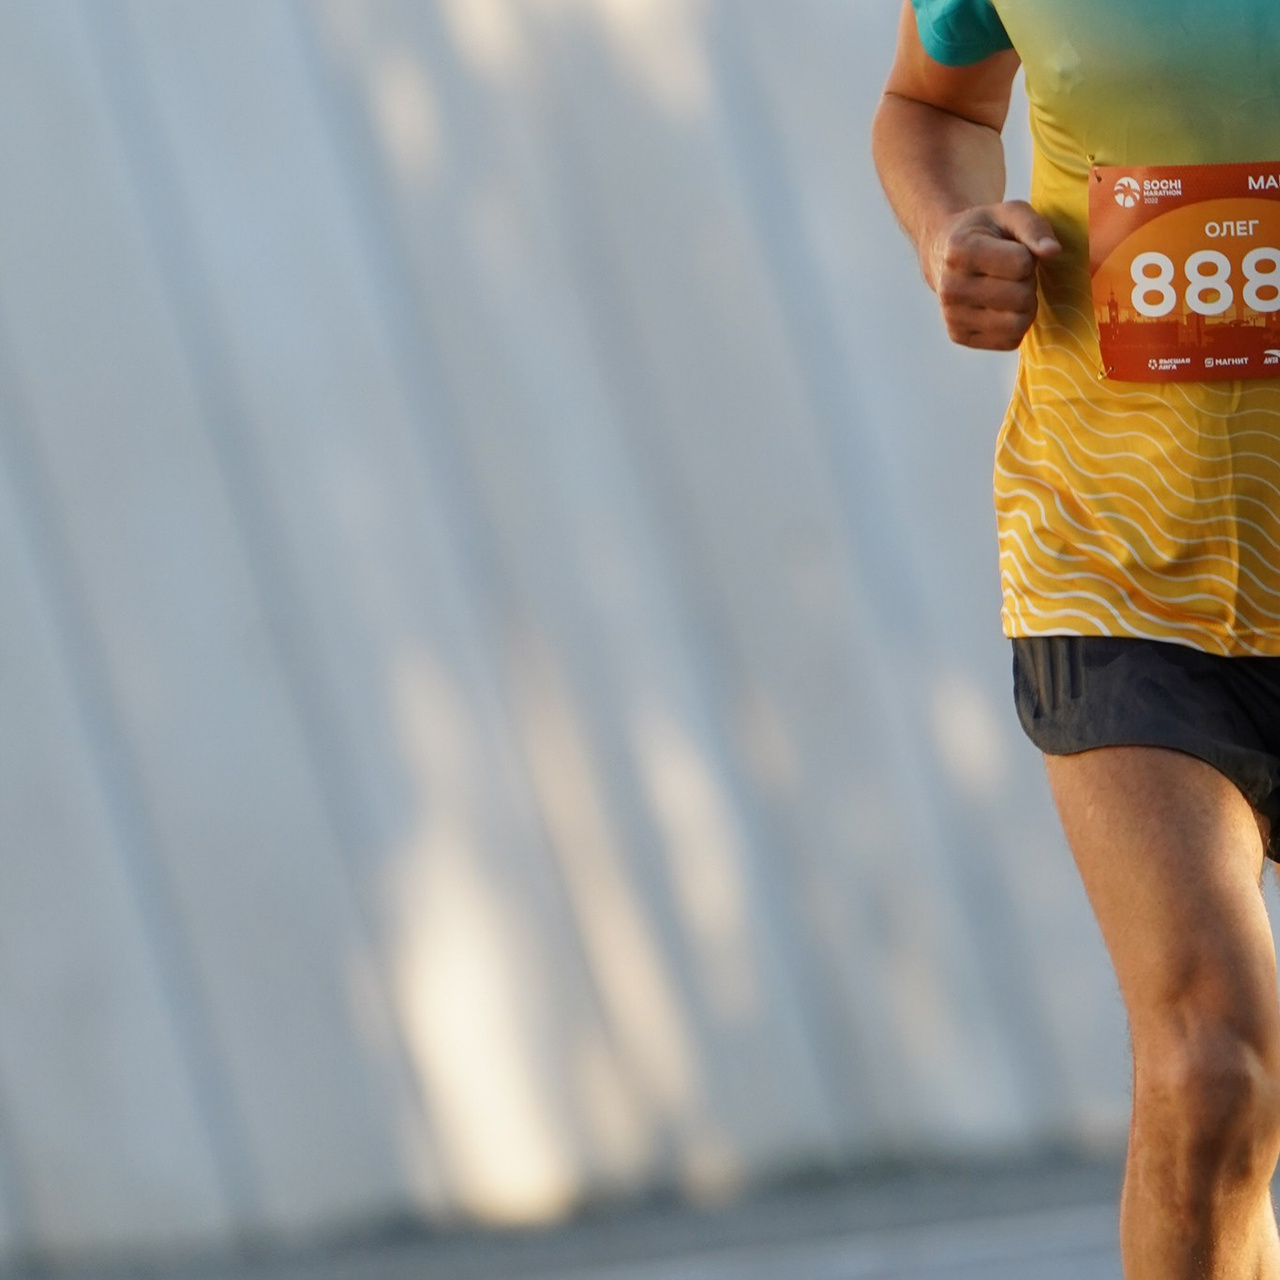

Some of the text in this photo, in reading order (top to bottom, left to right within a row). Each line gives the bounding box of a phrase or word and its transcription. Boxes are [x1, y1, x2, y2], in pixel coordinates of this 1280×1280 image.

[1143, 179, 1182, 190] SOCHI
[1204, 220, 1259, 238] ОЛЕГ
[1215, 357, 1249, 366] МАГНИТ
